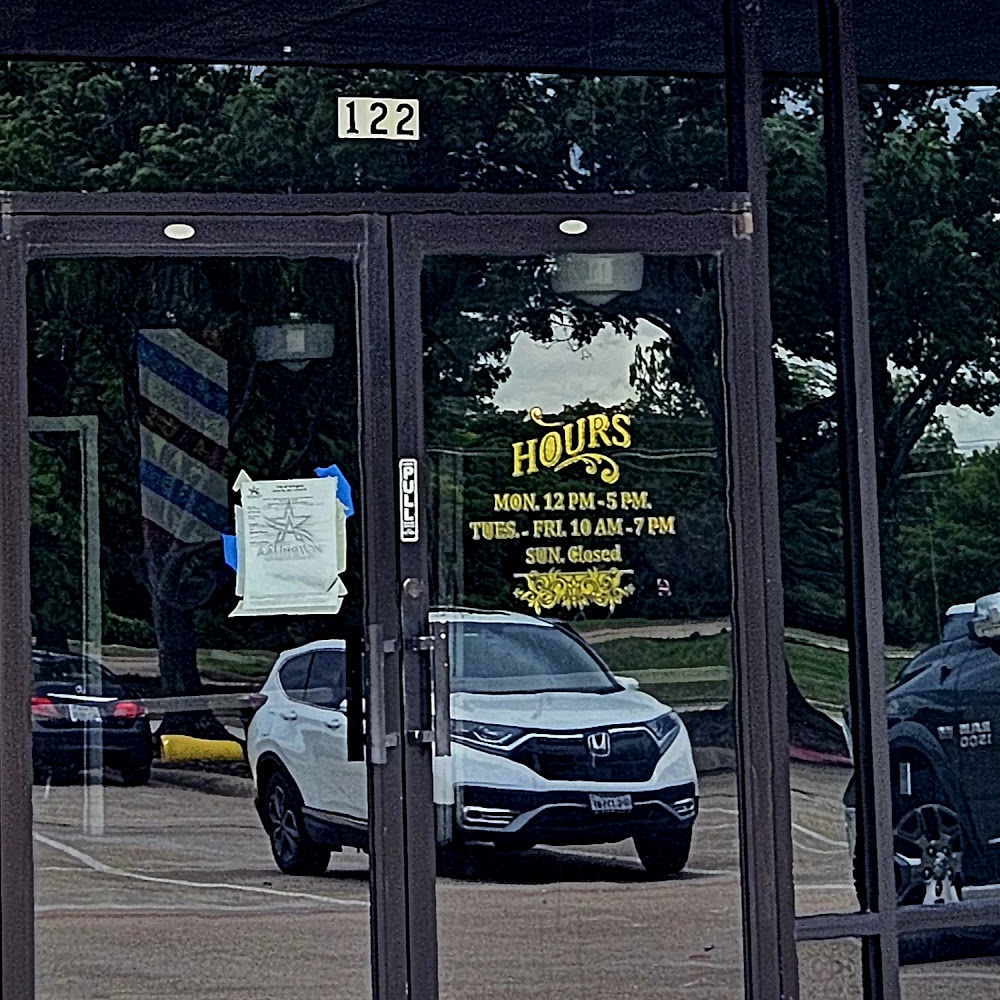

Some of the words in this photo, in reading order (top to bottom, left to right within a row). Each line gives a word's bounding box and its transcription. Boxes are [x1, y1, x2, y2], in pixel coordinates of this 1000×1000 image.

[346, 101, 414, 136] 122
[511, 413, 632, 478] HOURS
[402, 466, 415, 521] PULL
[493, 492, 540, 511] MON.
[543, 492, 565, 510] 12
[568, 492, 596, 510] PM
[620, 491, 653, 510] PM.
[469, 521, 520, 540] TUES.
[532, 519, 568, 538] FRI.
[570, 518, 592, 536] 10
[594, 517, 624, 536] AM
[647, 516, 676, 535] PM
[525, 546, 566, 565] SUN.
[567, 544, 623, 563] Closed
